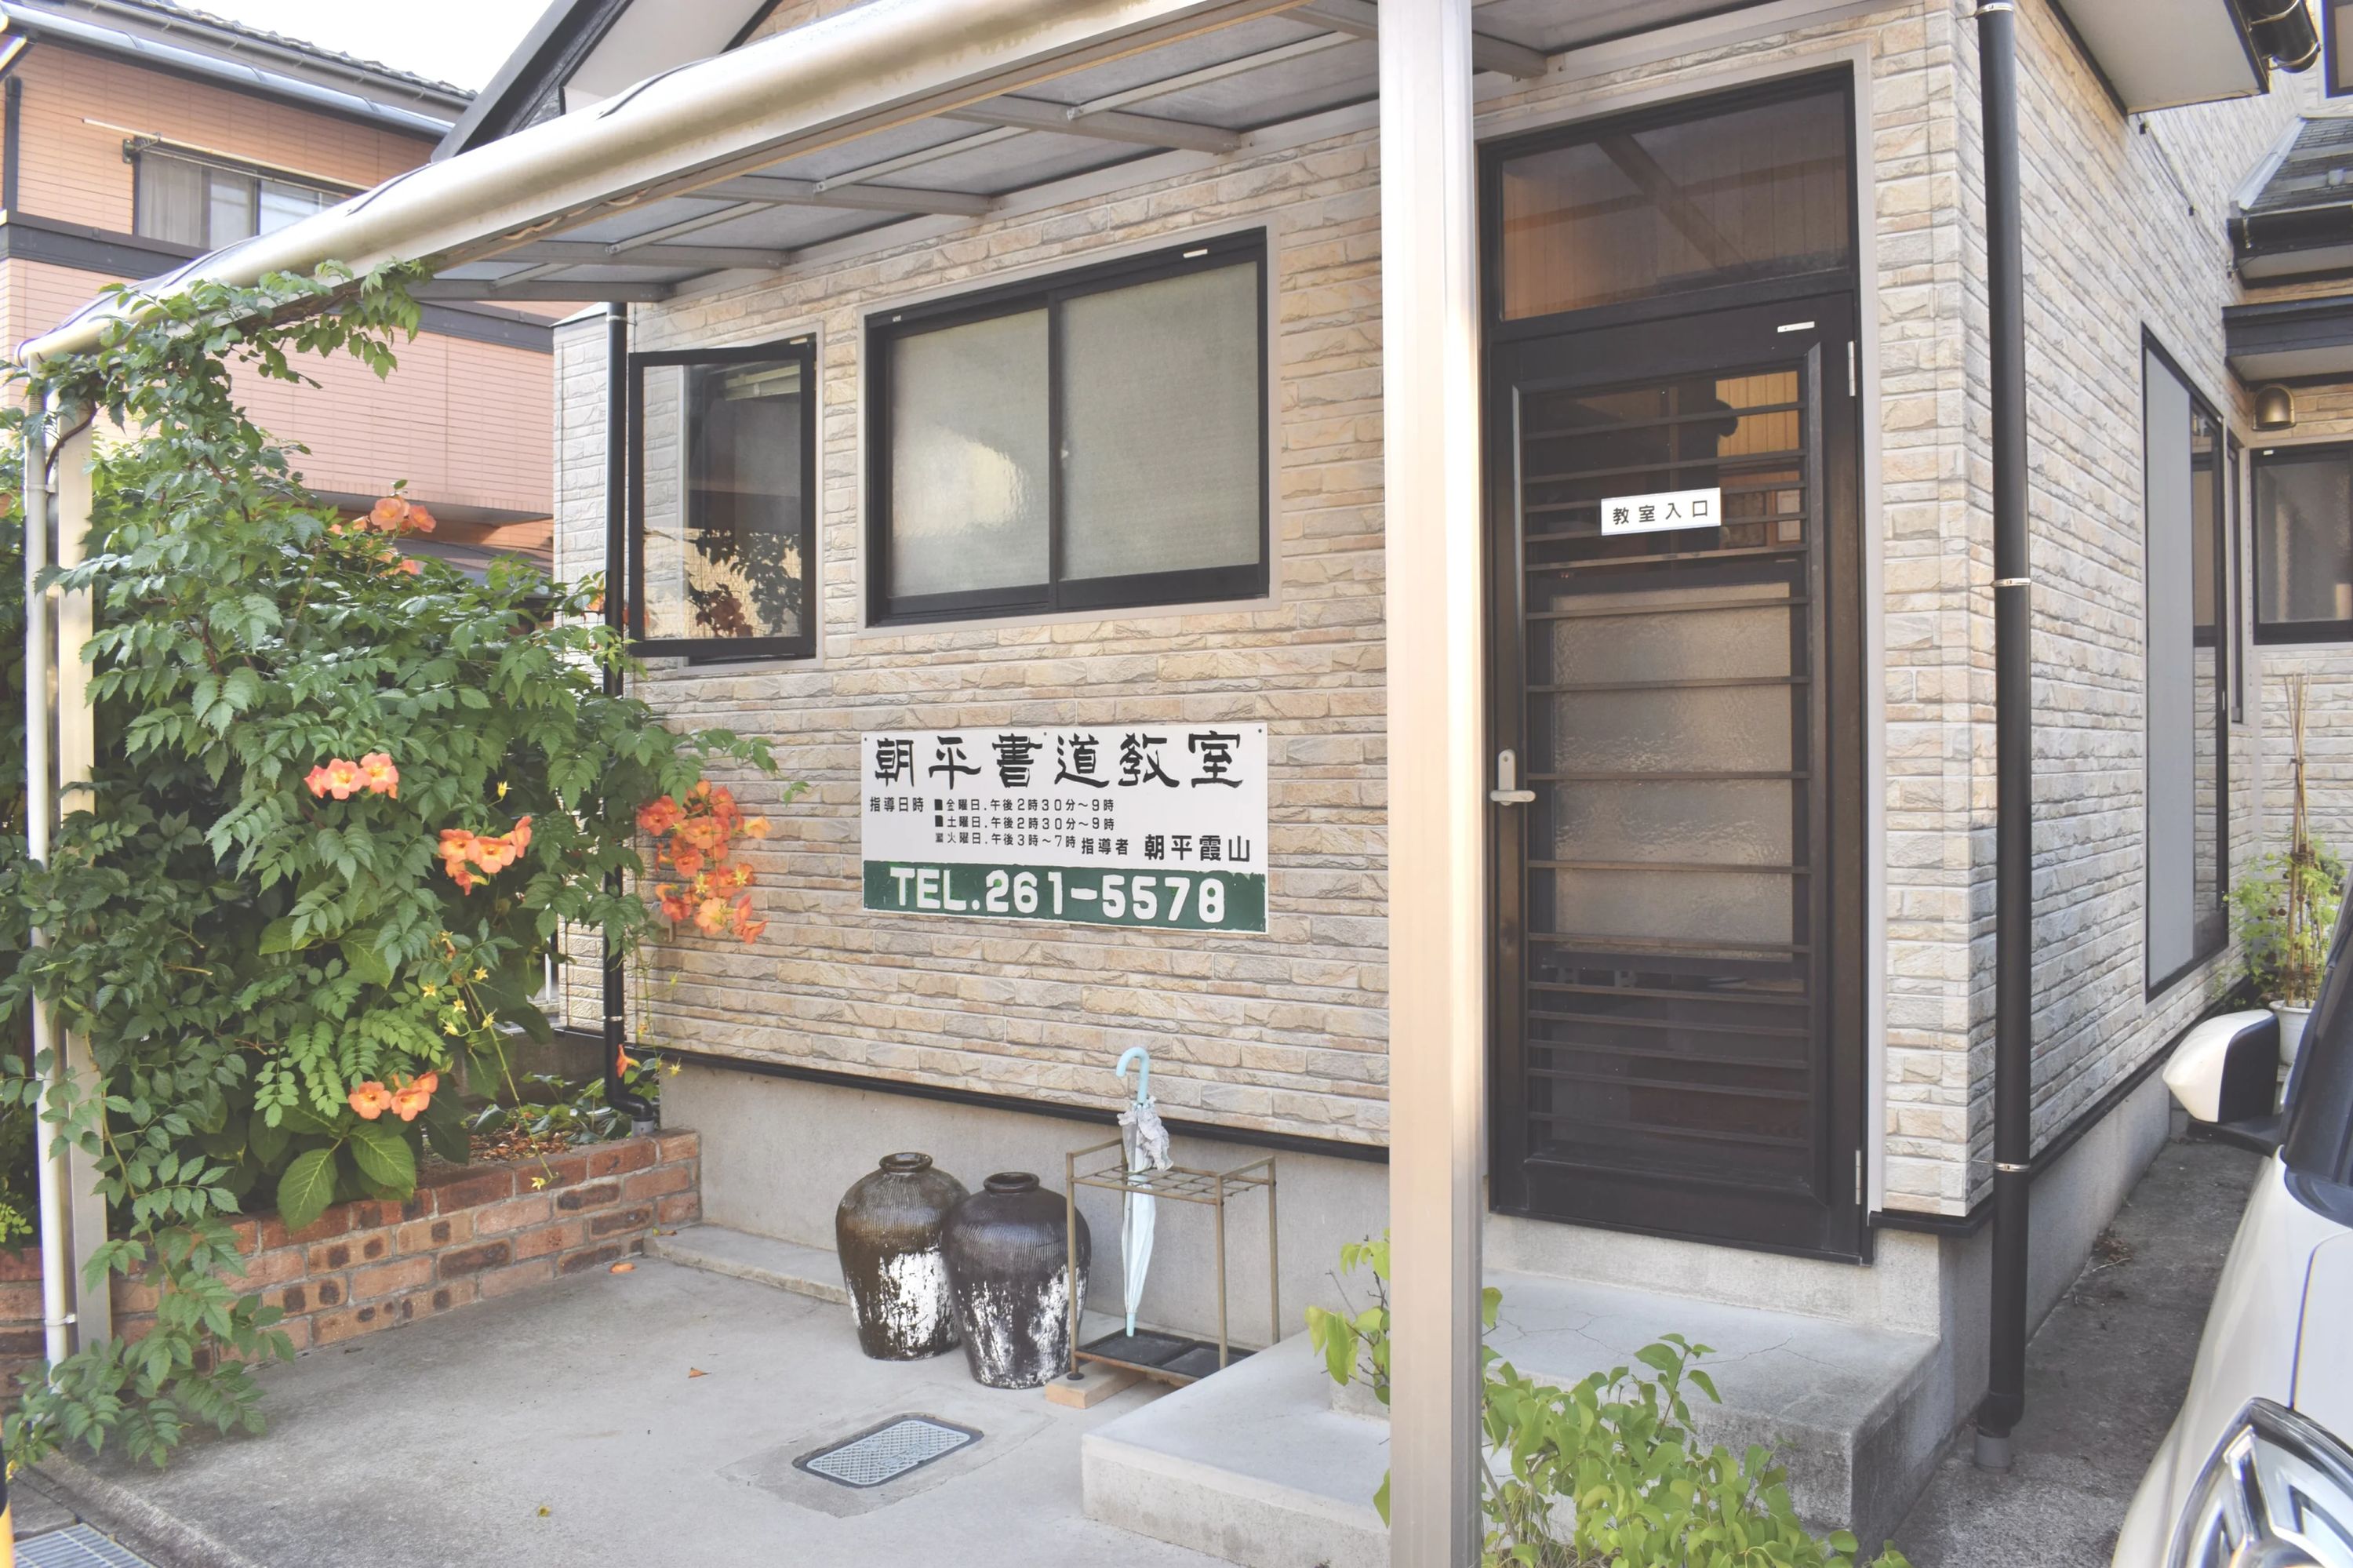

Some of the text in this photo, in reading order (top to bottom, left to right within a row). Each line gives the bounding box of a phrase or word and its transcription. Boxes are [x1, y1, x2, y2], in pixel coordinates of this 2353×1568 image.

[1612, 500, 1709, 526] 教室入口
[875, 729, 1244, 790] 朝平書道教室
[870, 796, 924, 813] 指導日時
[1081, 834, 1251, 863] 指導者 朝平霞山
